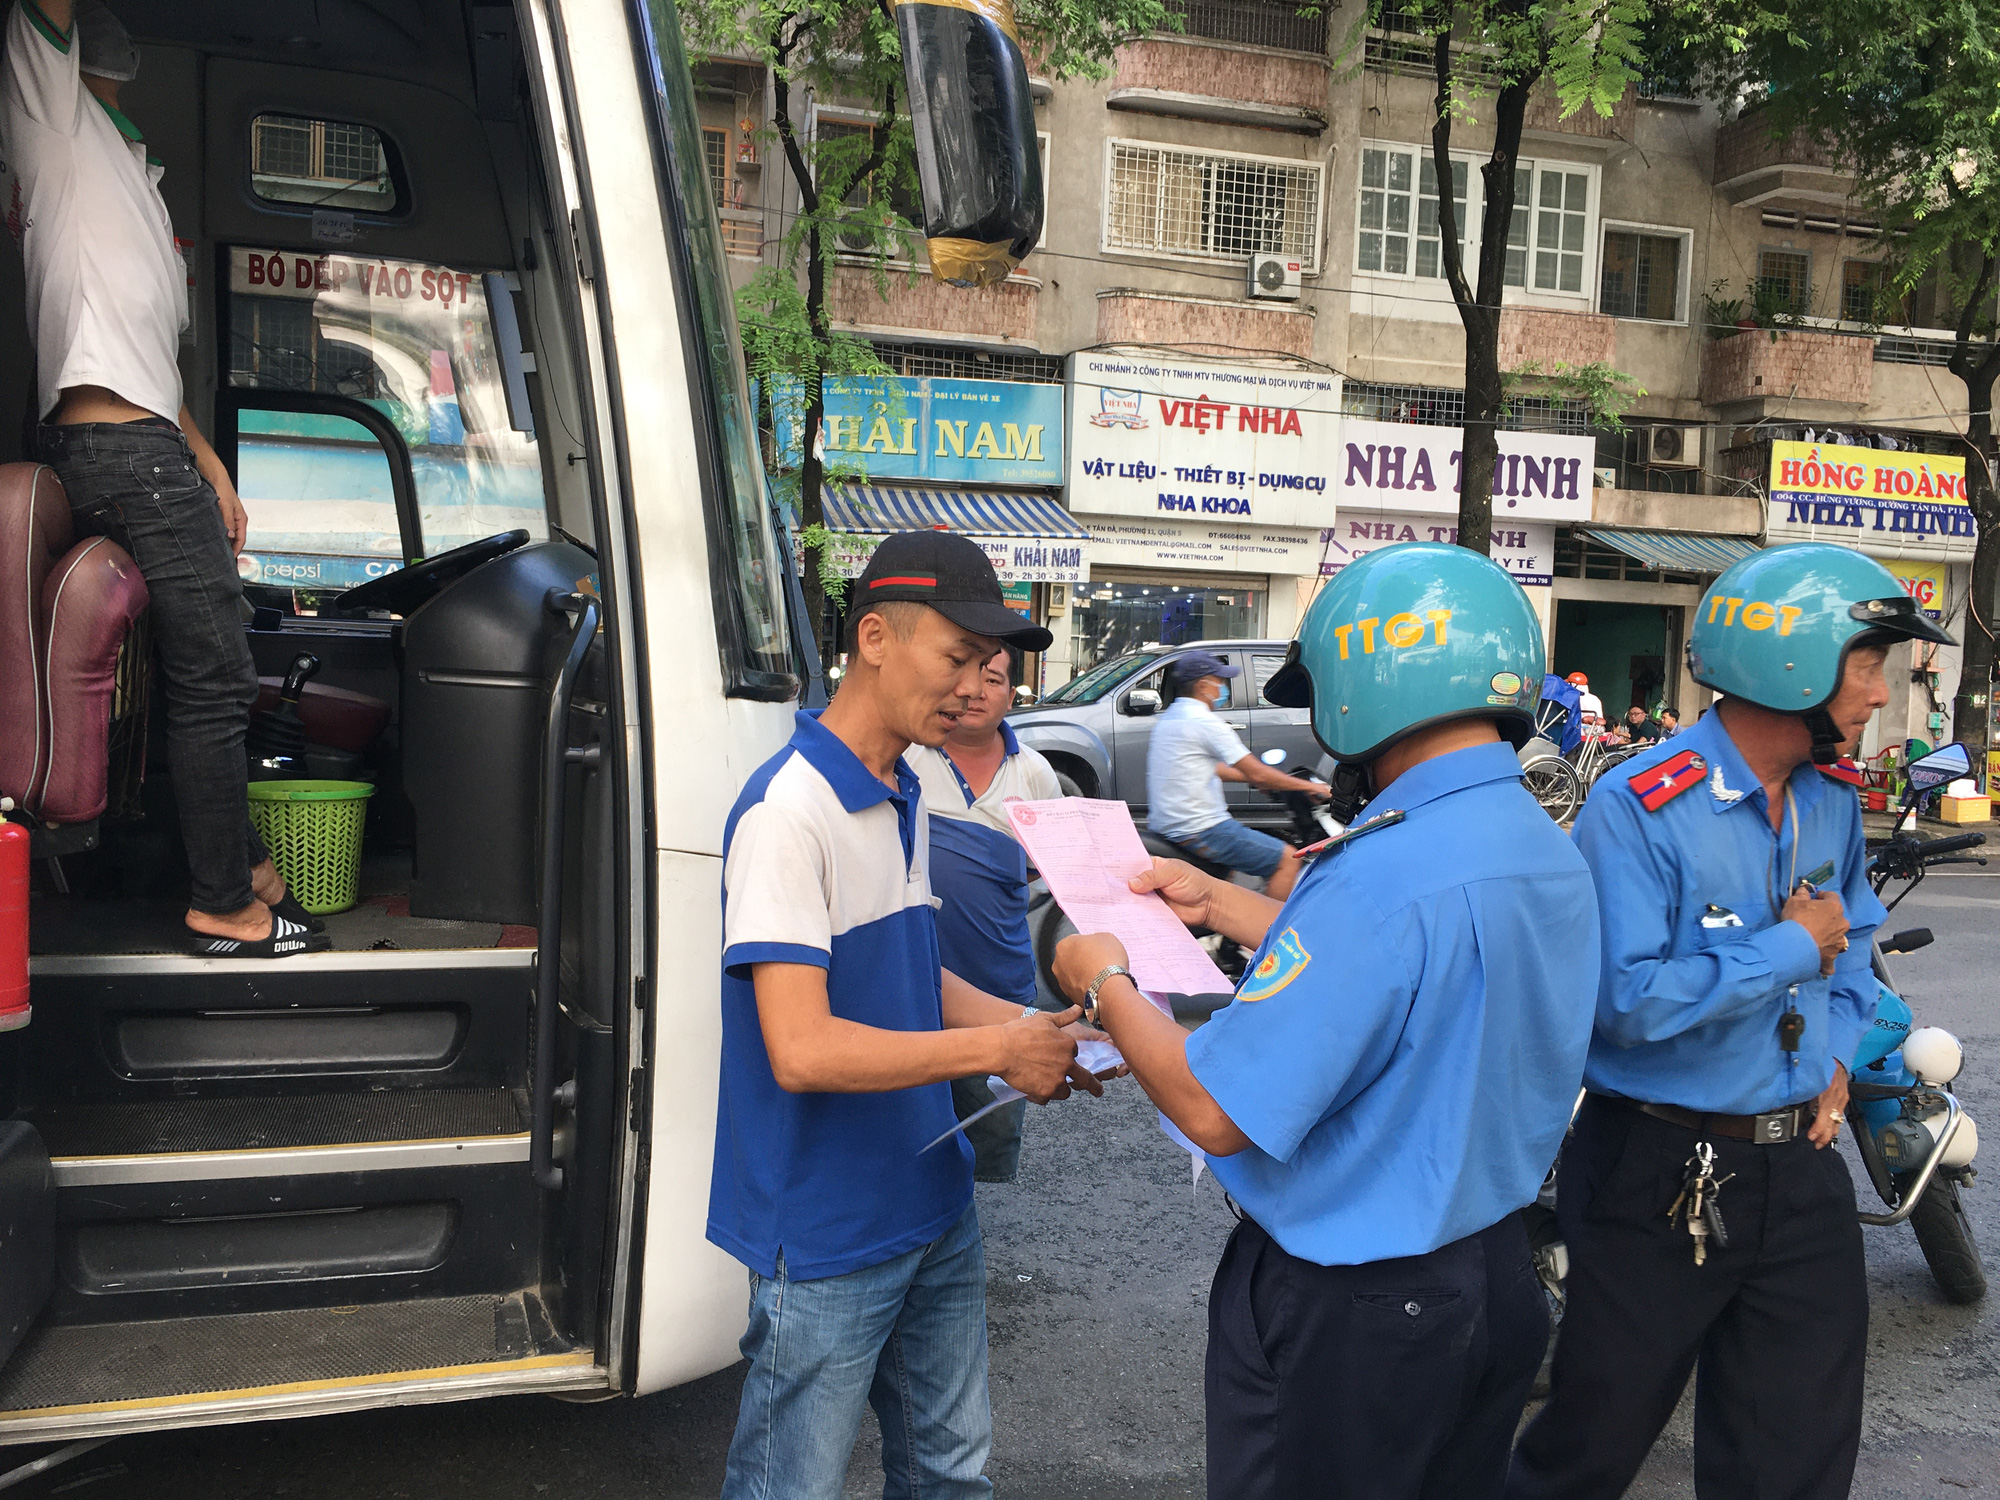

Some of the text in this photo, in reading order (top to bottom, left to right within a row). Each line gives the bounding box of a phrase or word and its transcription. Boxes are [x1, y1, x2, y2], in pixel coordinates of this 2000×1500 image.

[356, 259, 412, 299] VÀO
[421, 269, 472, 310] SỌT
[1089, 362, 1332, 392] CHI NHÁNH 2 CÔNG TY TNHH MTV THƯƠNG MẠI VÀ DỊCH VỤ VIỆT NHA
[934, 392, 948, 401] ĐẠI
[950, 391, 960, 400] LÝ
[991, 395, 1001, 403] XE
[1123, 401, 1138, 409] NHA
[1159, 394, 1303, 437] VIỆT NHA
[935, 418, 1045, 462] NAM
[1082, 457, 1116, 480] VẬT
[1119, 460, 1156, 483] LIỆU
[1174, 463, 1223, 484] THIẾT
[1226, 471, 1246, 490] BỊ
[1345, 442, 1438, 492] NHA
[1779, 448, 1866, 492] HỒNG
[1158, 493, 1252, 516] NHA KHOA
[1816, 494, 1842, 504] HÙNG
[1786, 502, 1865, 528] NHA
[1349, 521, 1528, 549] NHA TNH
[1014, 539, 1081, 568] KHẢI NAM
[1156, 552, 1224, 562] WWW.VIETNHA.COM
[1516, 556, 1538, 570] TẾ
[263, 563, 321, 581] pepsi
[1002, 571, 1013, 580] 30
[1022, 571, 1033, 580] 2h
[1035, 572, 1047, 581] 30
[1055, 572, 1066, 581] 3h
[1068, 573, 1079, 581] 30
[1706, 595, 1803, 637] TTGT
[1334, 609, 1452, 661] TTGT
